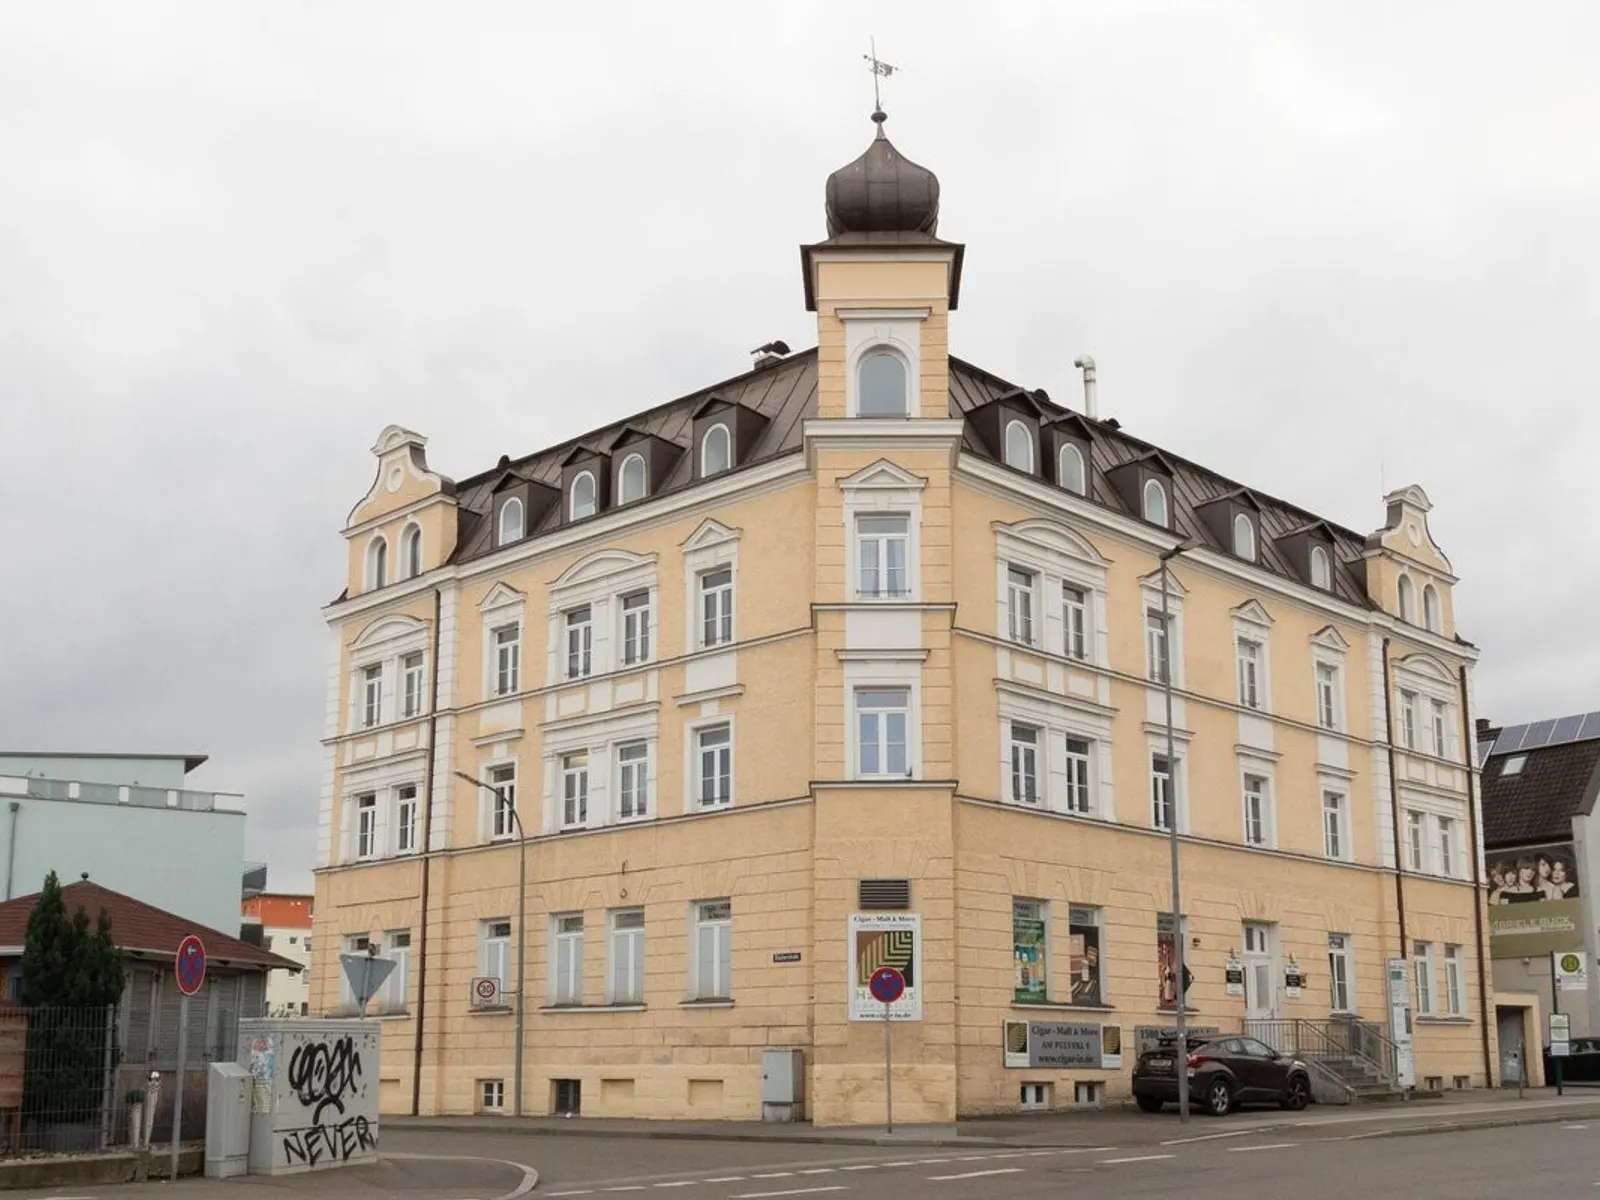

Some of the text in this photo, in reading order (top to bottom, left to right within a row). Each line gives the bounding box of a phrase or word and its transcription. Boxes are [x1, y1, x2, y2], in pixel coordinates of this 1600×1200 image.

[480, 984, 492, 994] 30
[1031, 1025, 1052, 1036] Cigar
[283, 1115, 377, 1166] NEVER
